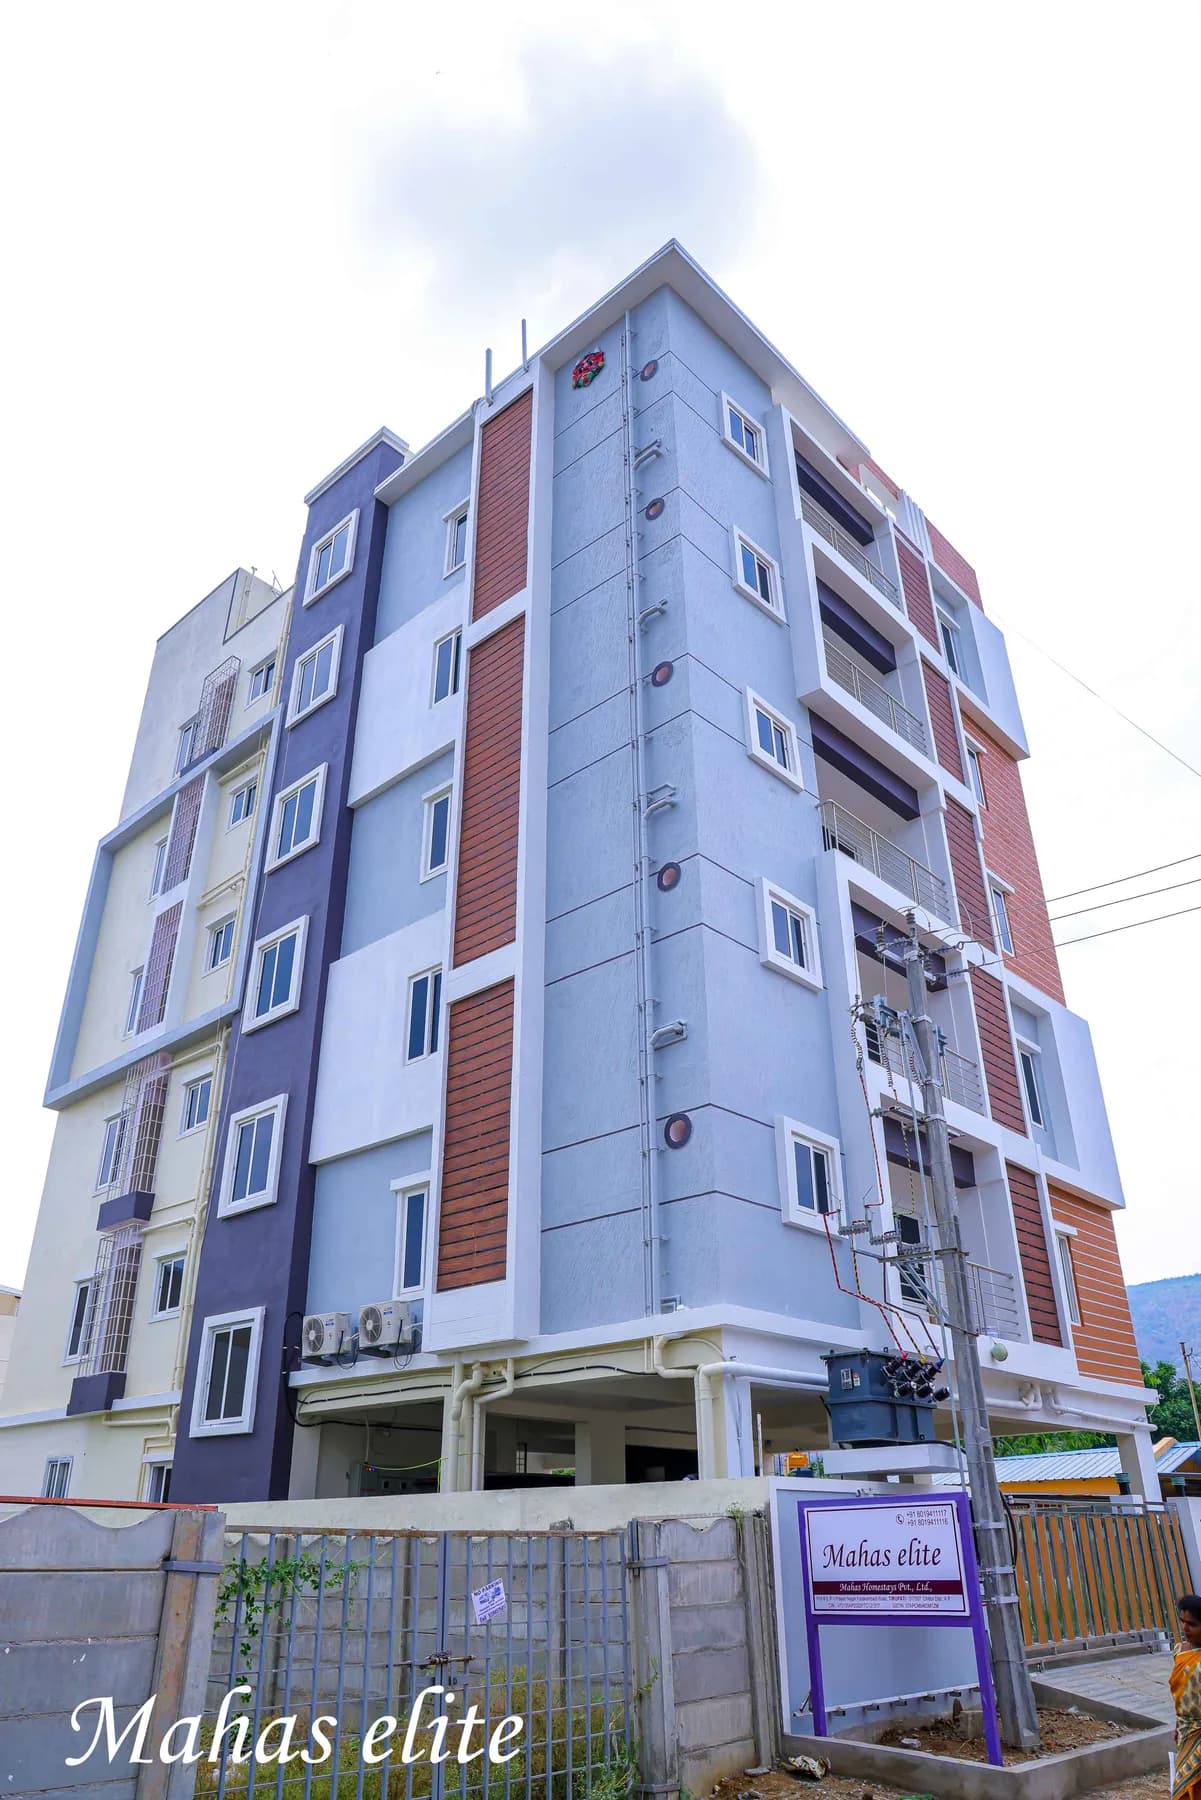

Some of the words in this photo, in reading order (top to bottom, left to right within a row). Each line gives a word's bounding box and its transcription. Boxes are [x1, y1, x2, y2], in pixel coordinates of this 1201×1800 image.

[823, 1540, 891, 1568] Mahas
[898, 1538, 941, 1566] elite
[840, 1582, 861, 1592] Mahas
[862, 1582, 897, 1593] Homestays
